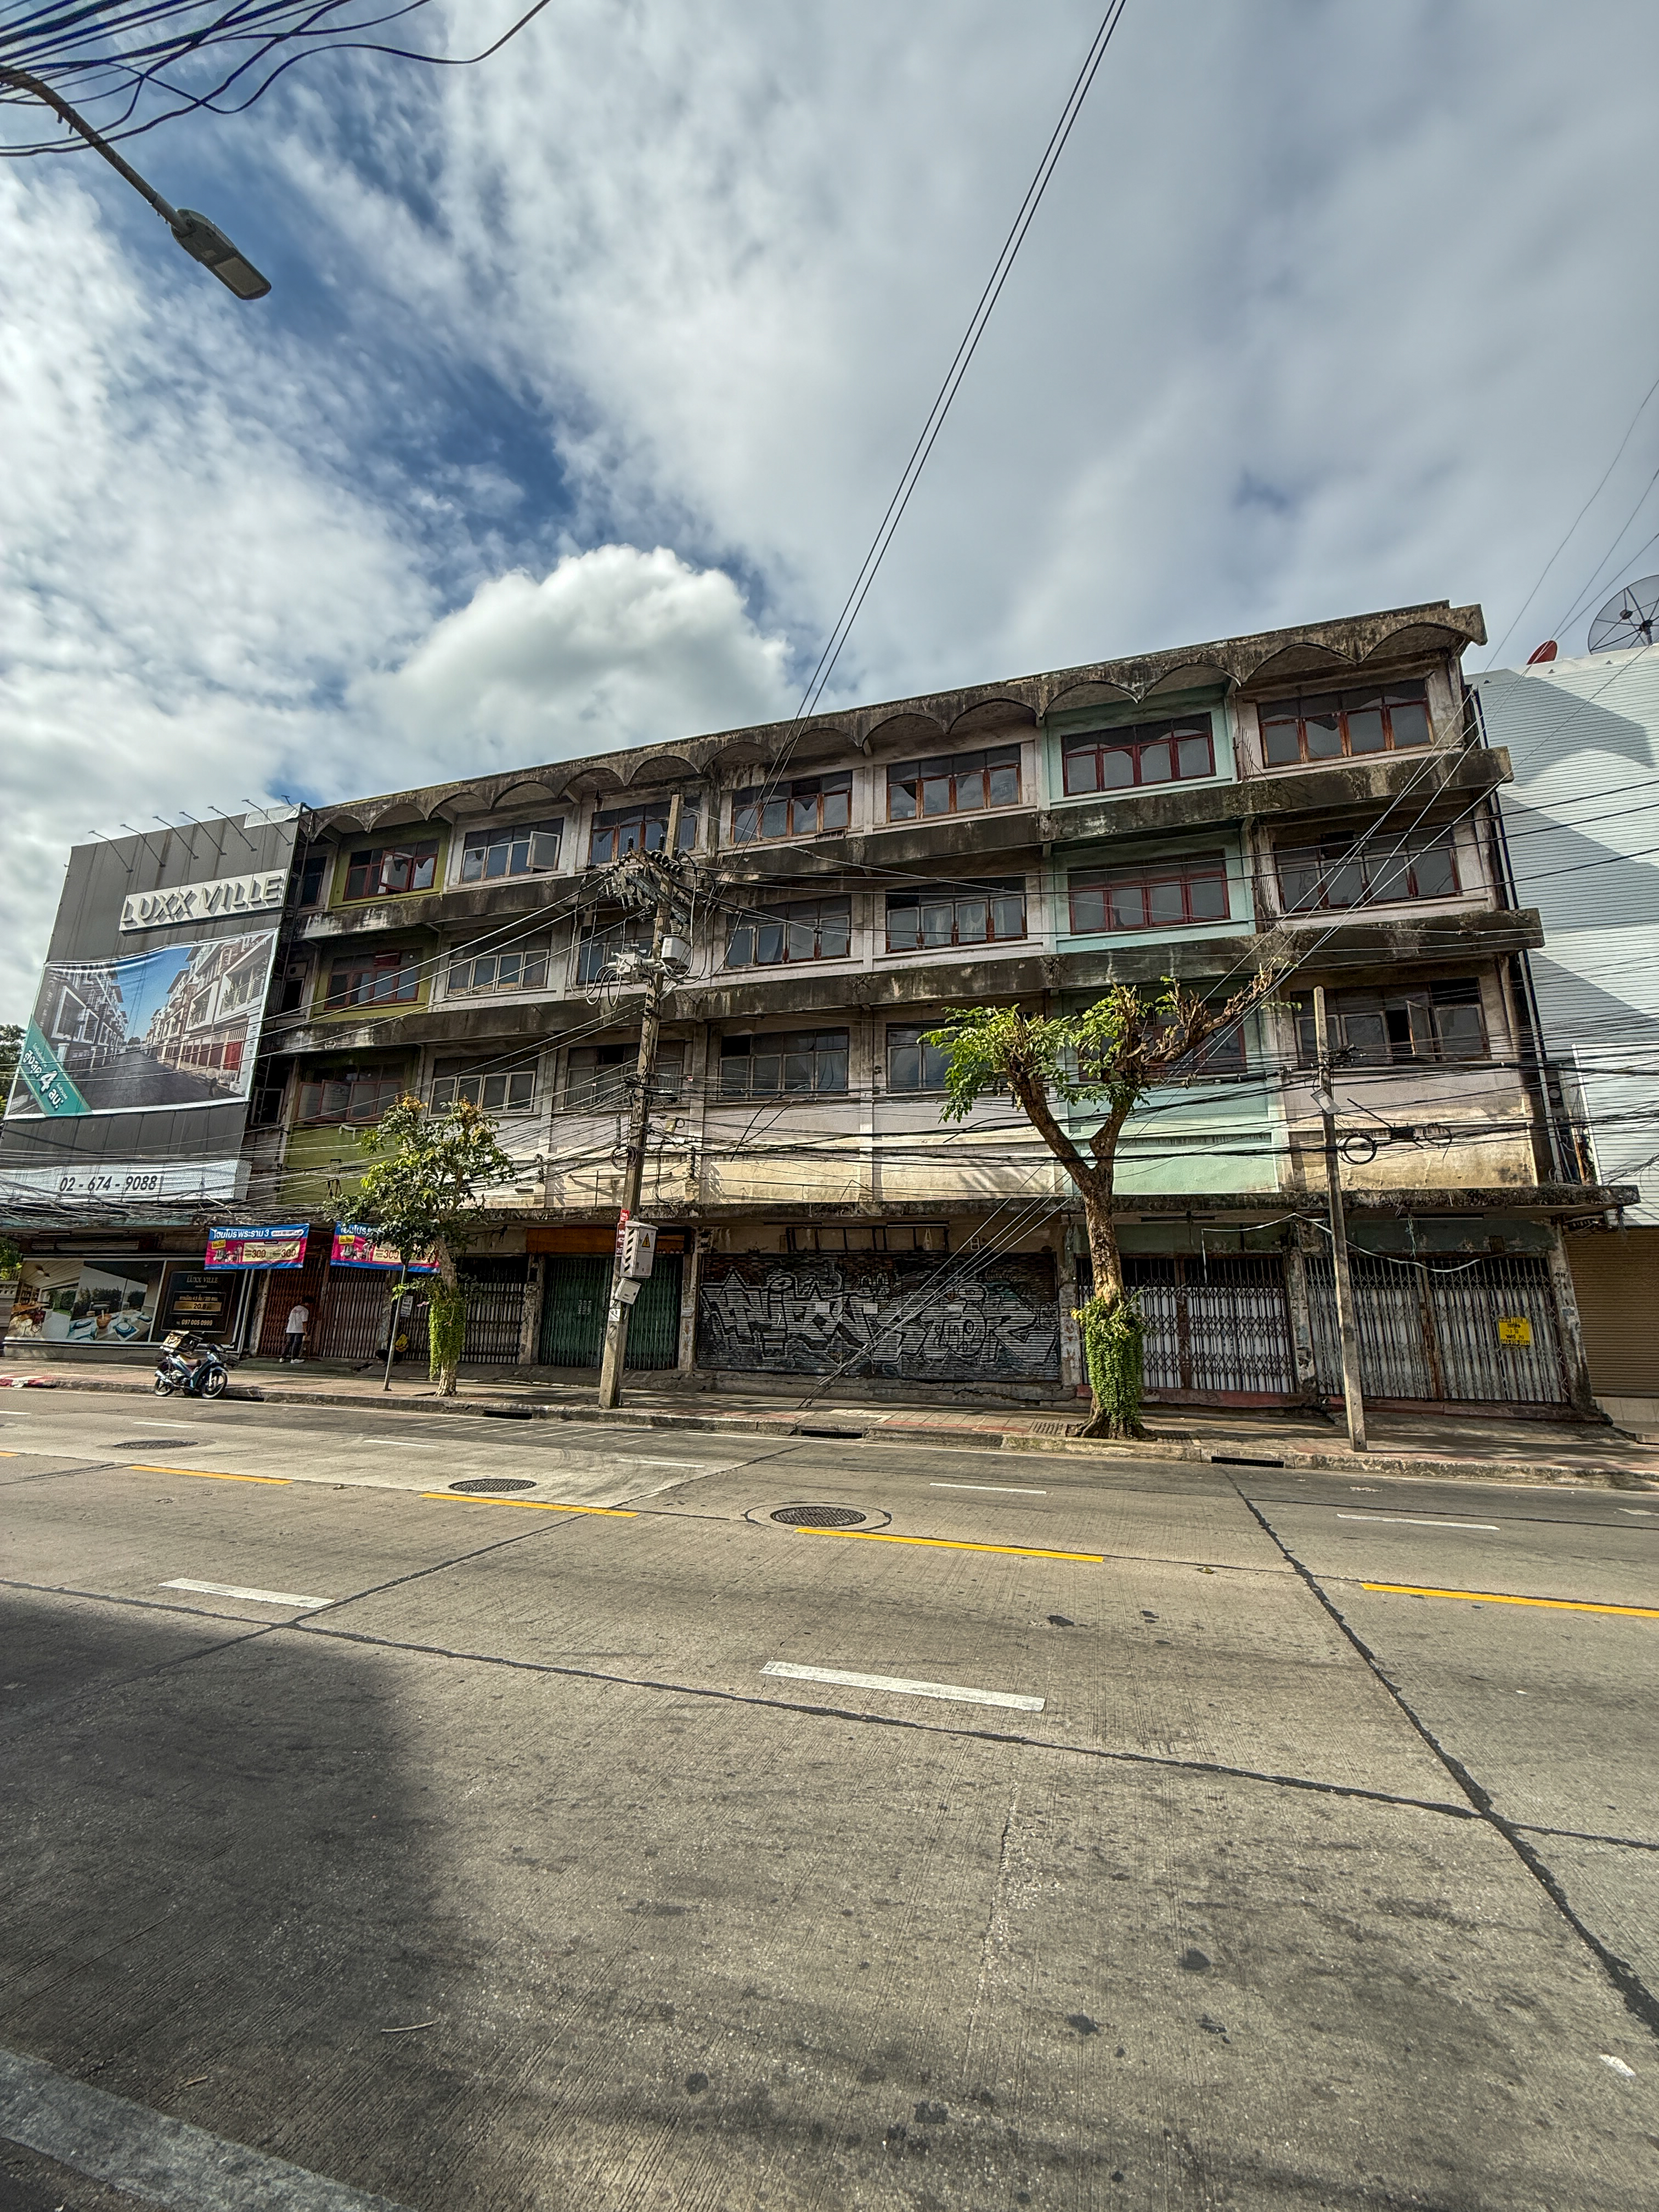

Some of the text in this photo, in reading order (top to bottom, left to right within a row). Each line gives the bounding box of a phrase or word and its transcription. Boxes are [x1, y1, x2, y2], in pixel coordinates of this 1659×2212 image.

[121, 876, 282, 922] LUXX VILLE
[40, 1070, 58, 1092] 4
[59, 1177, 76, 1192] 02
[87, 1176, 112, 1192] 674
[125, 1175, 157, 1192] 9088
